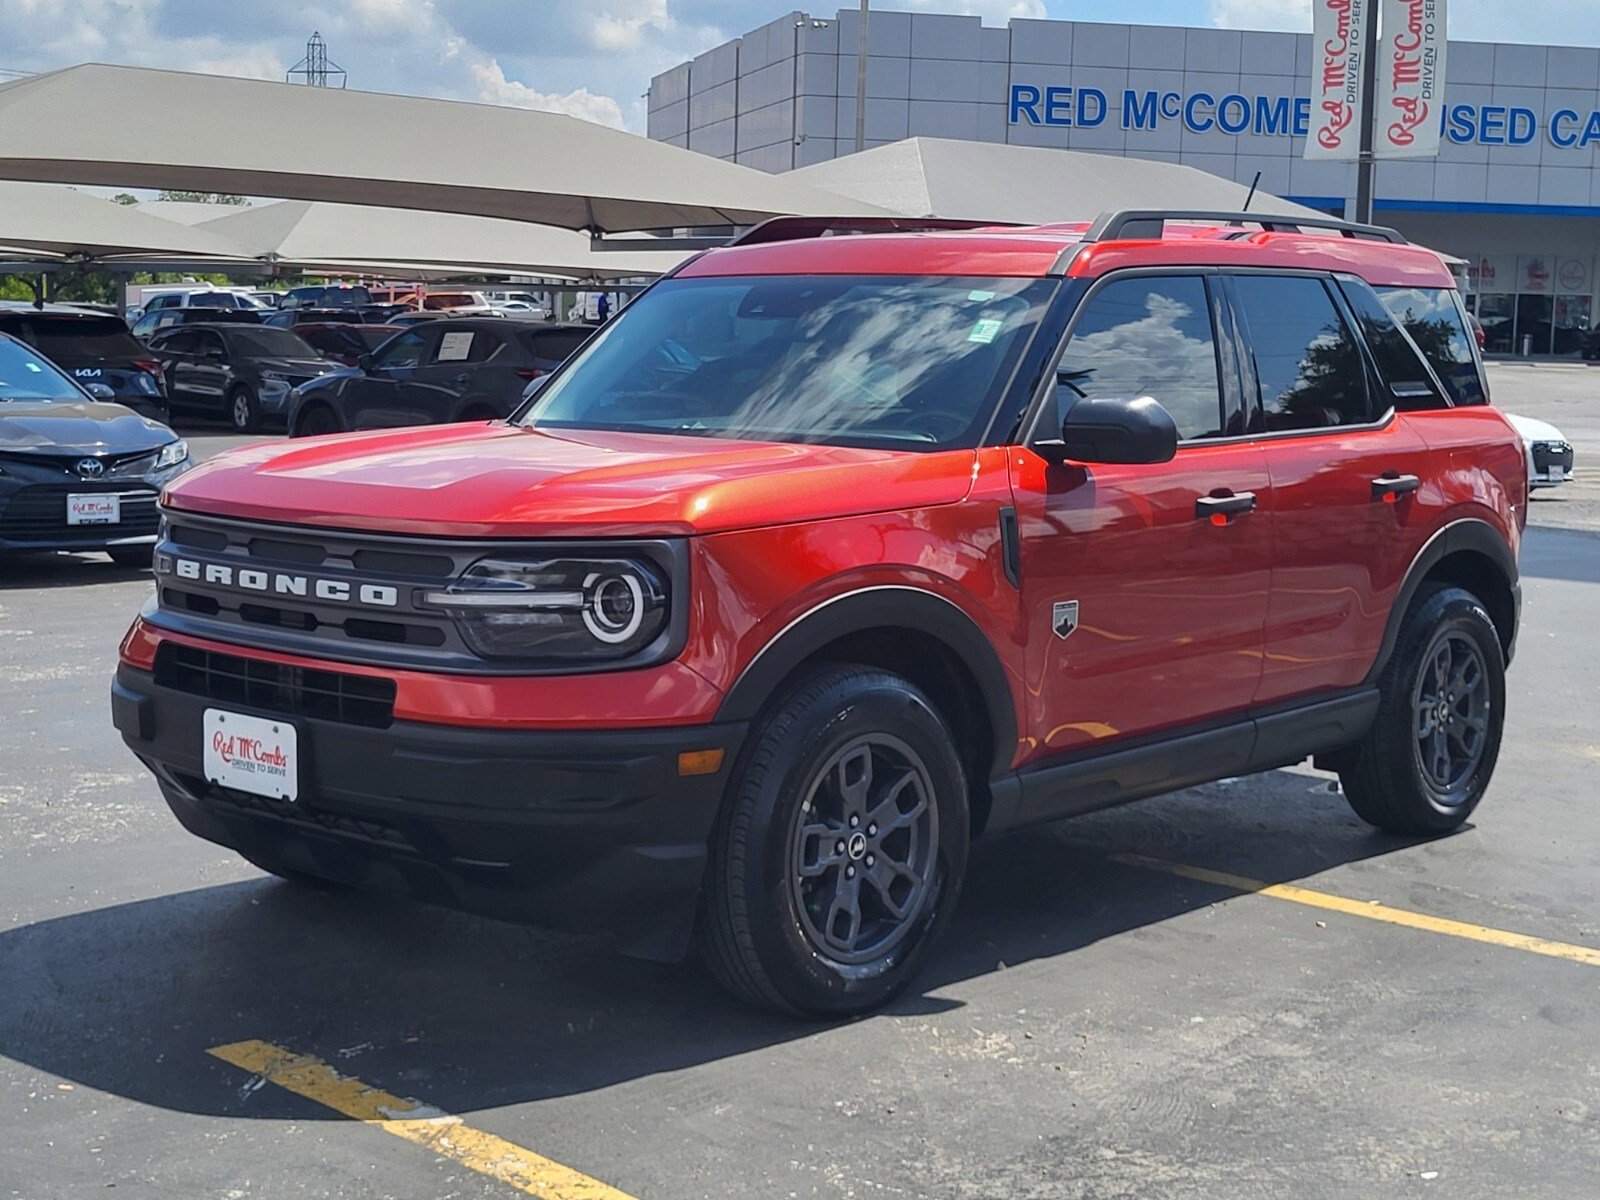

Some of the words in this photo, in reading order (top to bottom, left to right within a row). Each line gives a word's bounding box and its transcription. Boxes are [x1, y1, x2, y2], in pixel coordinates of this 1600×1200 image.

[1424, 23, 1435, 43] TO
[1425, 0, 1435, 19] SE
[1349, 29, 1359, 48] TO
[1346, 52, 1358, 103] DRIVEN
[1421, 47, 1434, 100] DRIVEN
[1009, 84, 1107, 127] RED
[1440, 104, 1537, 145] SED
[1317, 100, 1353, 149] Red
[1387, 96, 1428, 146] Red
[176, 558, 398, 607] BRONCO
[213, 731, 235, 763] Red
[232, 759, 255, 771] DRIVEN
[256, 763, 266, 772] TO
[267, 766, 286, 777] SERVE
